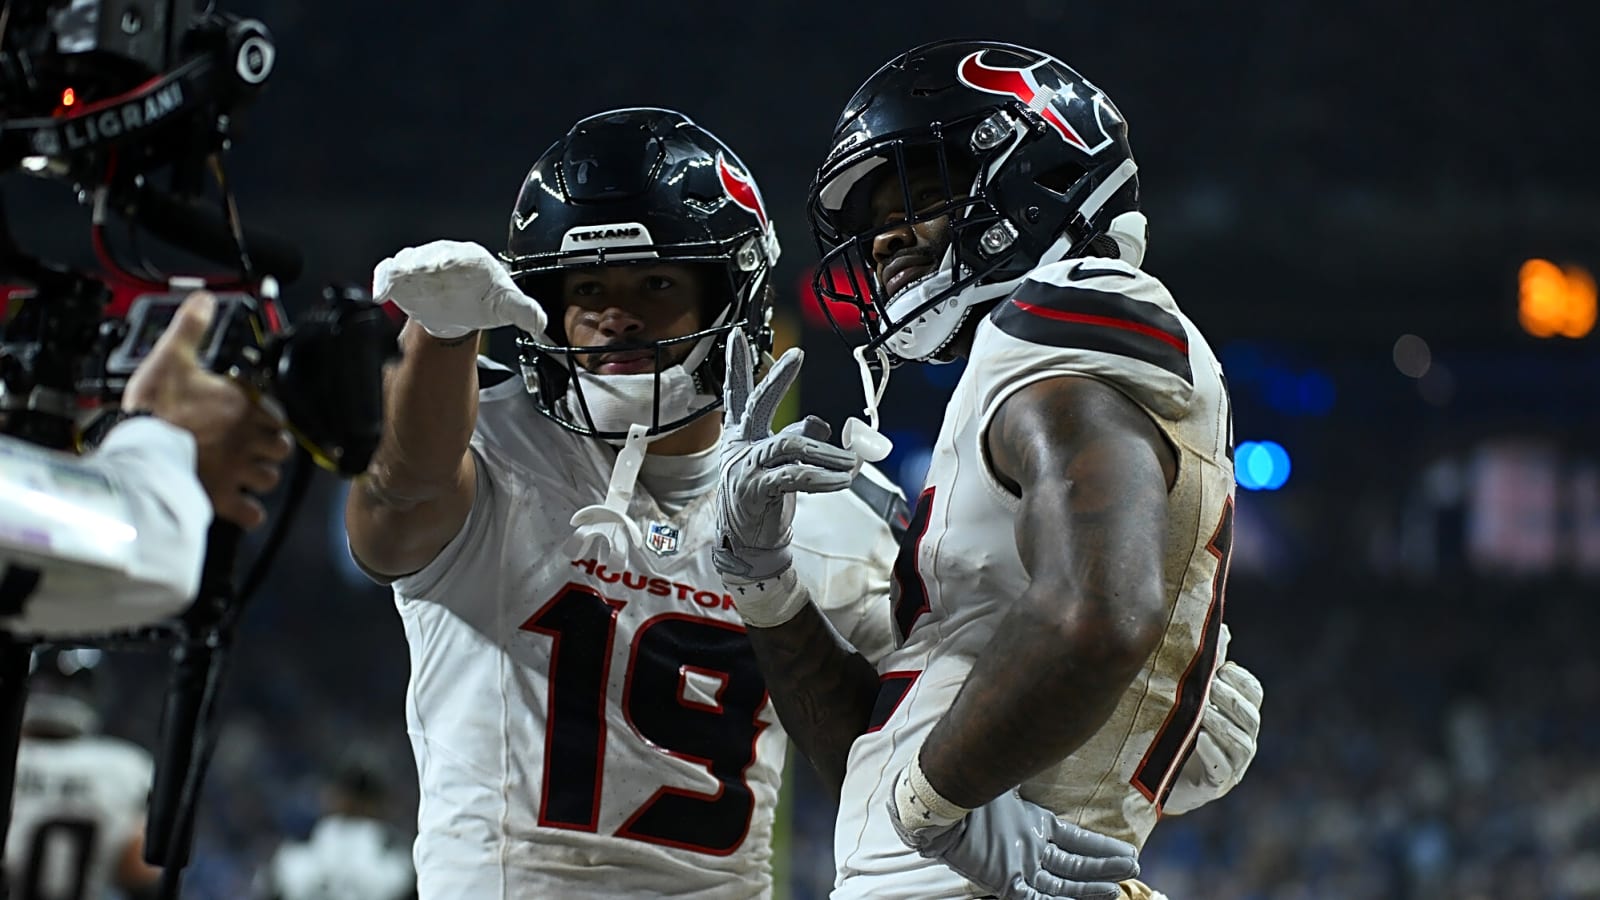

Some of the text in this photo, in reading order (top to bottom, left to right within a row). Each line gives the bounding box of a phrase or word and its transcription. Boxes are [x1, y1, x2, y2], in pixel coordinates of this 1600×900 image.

[569, 228, 641, 242] TEXANS
[653, 534, 674, 550] NFL
[518, 581, 771, 856] 19
